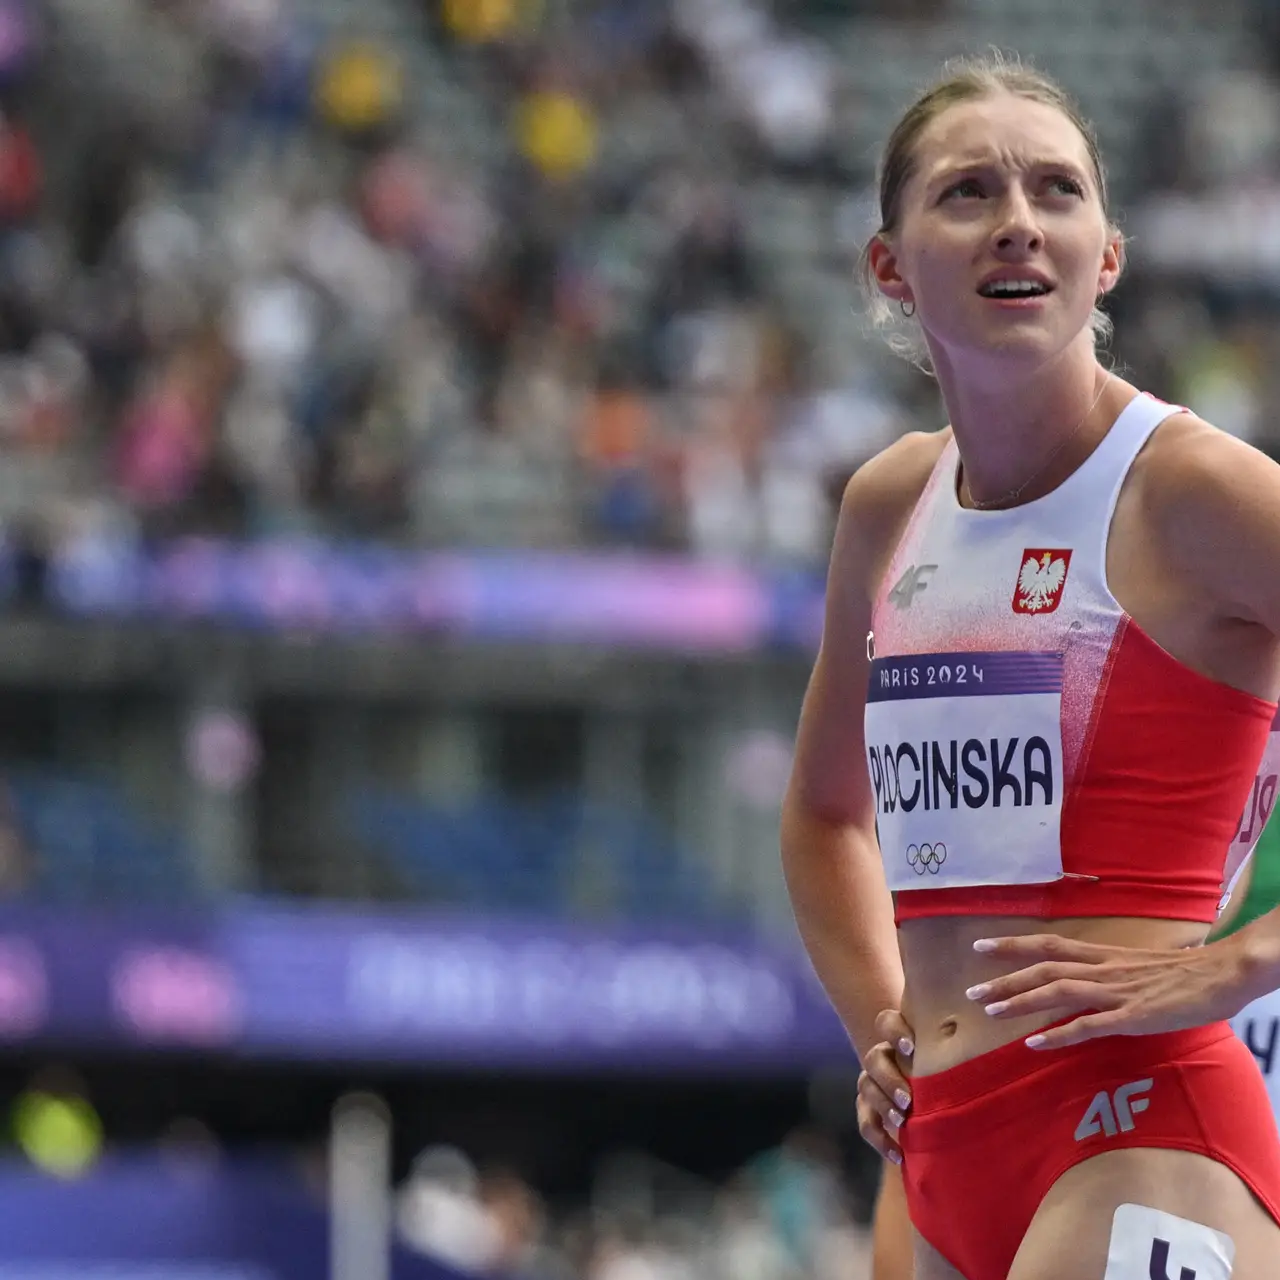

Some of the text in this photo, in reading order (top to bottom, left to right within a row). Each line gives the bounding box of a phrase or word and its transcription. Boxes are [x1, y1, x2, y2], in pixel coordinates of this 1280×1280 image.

[927, 664, 984, 686] 2024
[868, 735, 1054, 815] PLOCINSKA
[1073, 1077, 1154, 1142] 4F
